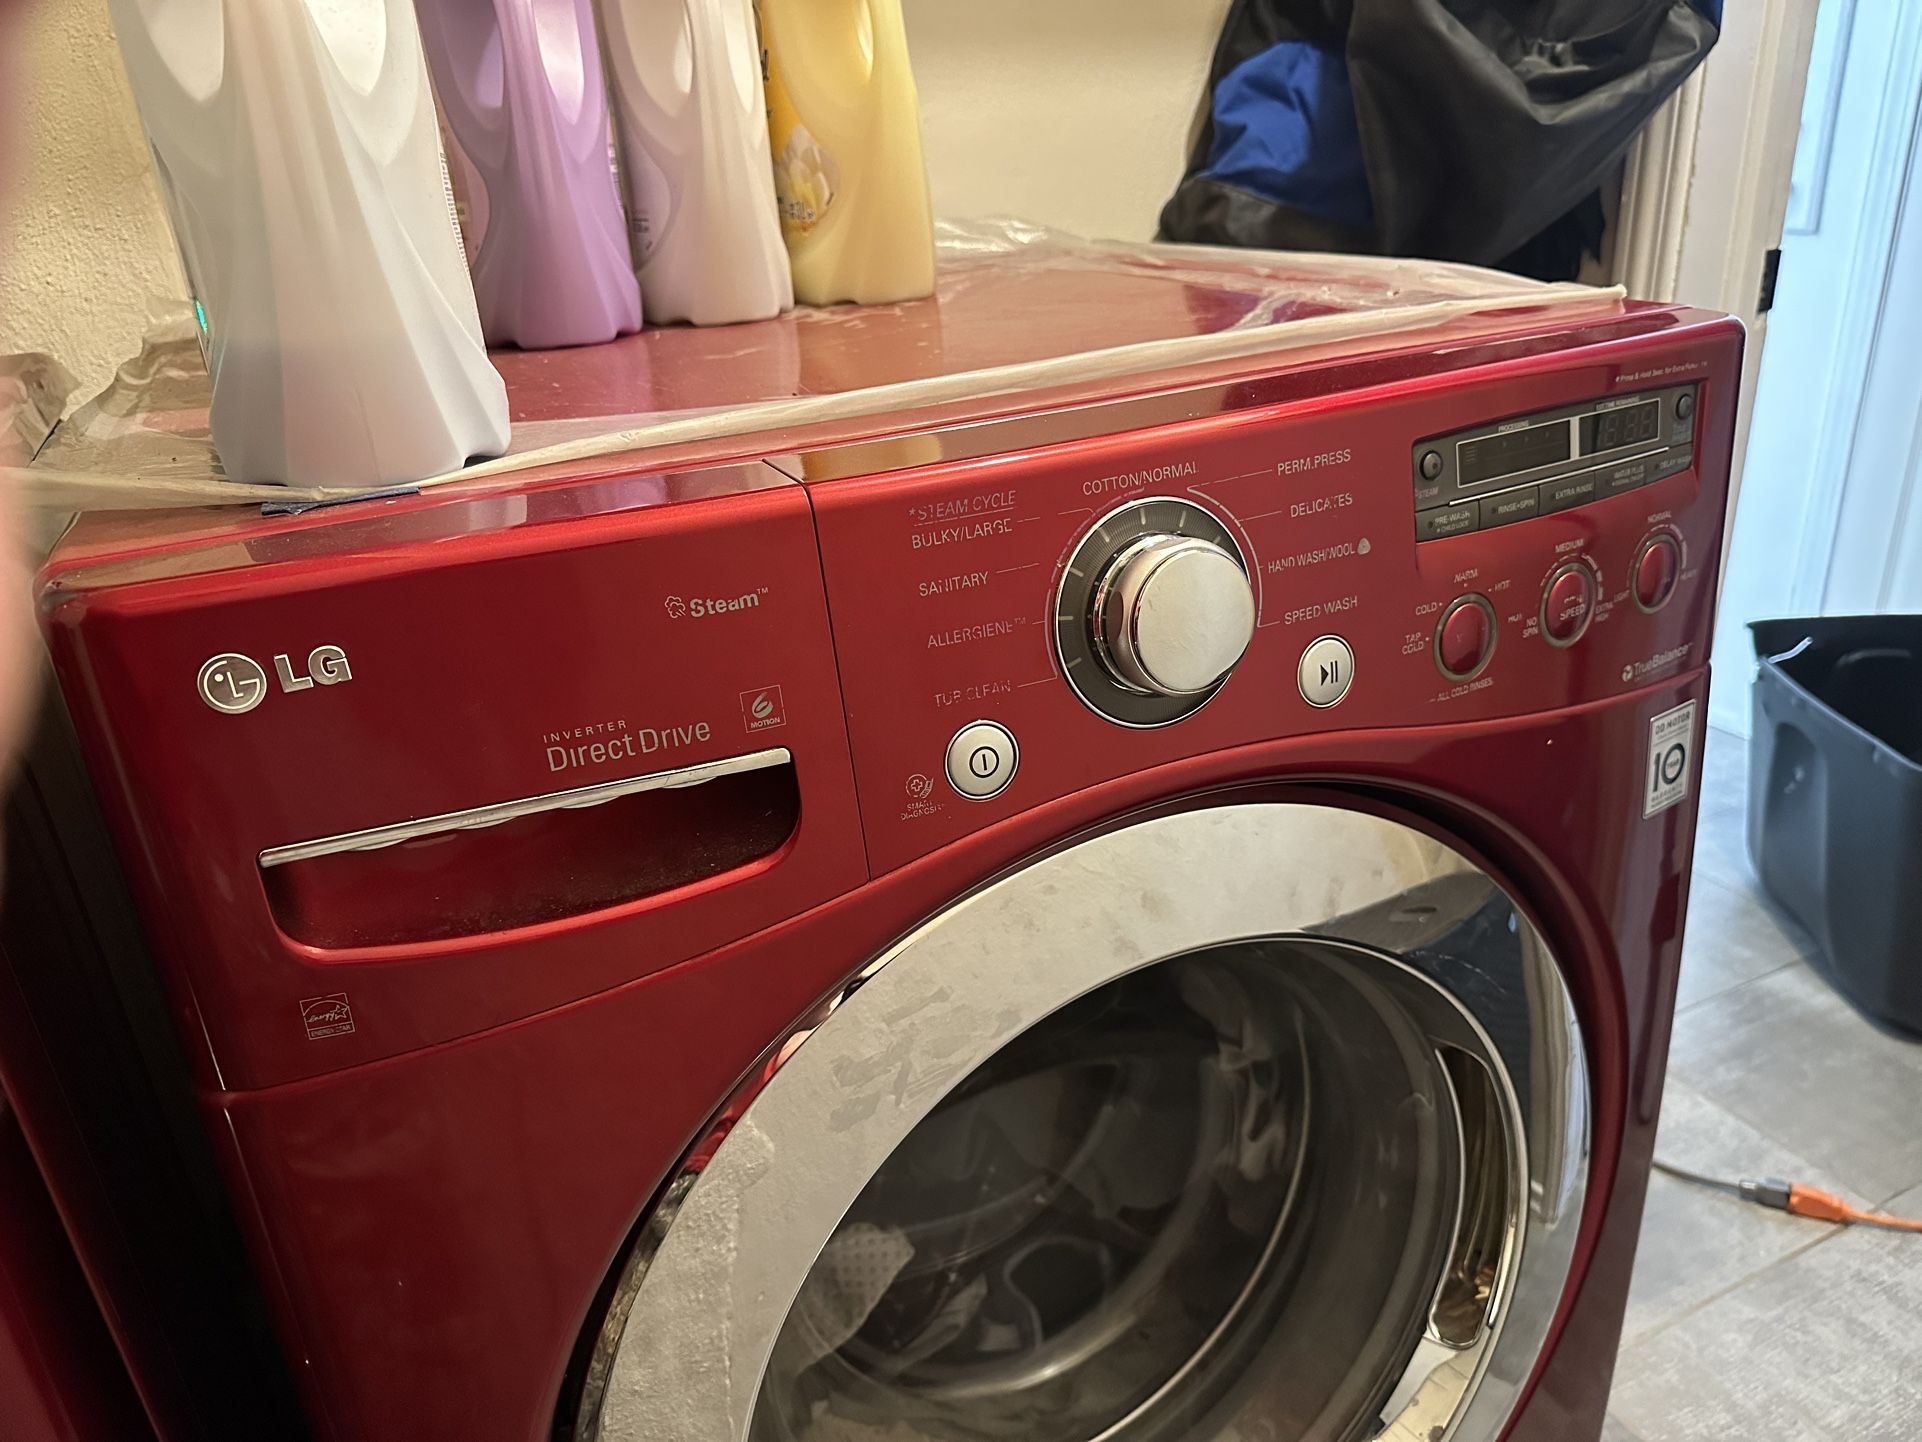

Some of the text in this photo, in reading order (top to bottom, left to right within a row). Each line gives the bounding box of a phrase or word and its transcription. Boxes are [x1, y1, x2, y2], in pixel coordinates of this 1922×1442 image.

[972, 490, 1017, 511] CYCLE
[1290, 493, 1353, 518] DELICATES
[912, 518, 1013, 549] BULKY/LARGE
[1555, 539, 1584, 553] MEDIUM
[1268, 556, 1295, 574] HAND
[919, 571, 989, 597] SANITARY
[1284, 595, 1358, 625] SPEED WASH
[1415, 602, 1437, 616] COLD
[274, 645, 352, 693] LG
[543, 719, 627, 743] INVERTER
[750, 716, 781, 729] MOTION
[546, 721, 711, 772] Direct Drive
[1653, 743, 1686, 792] 10
